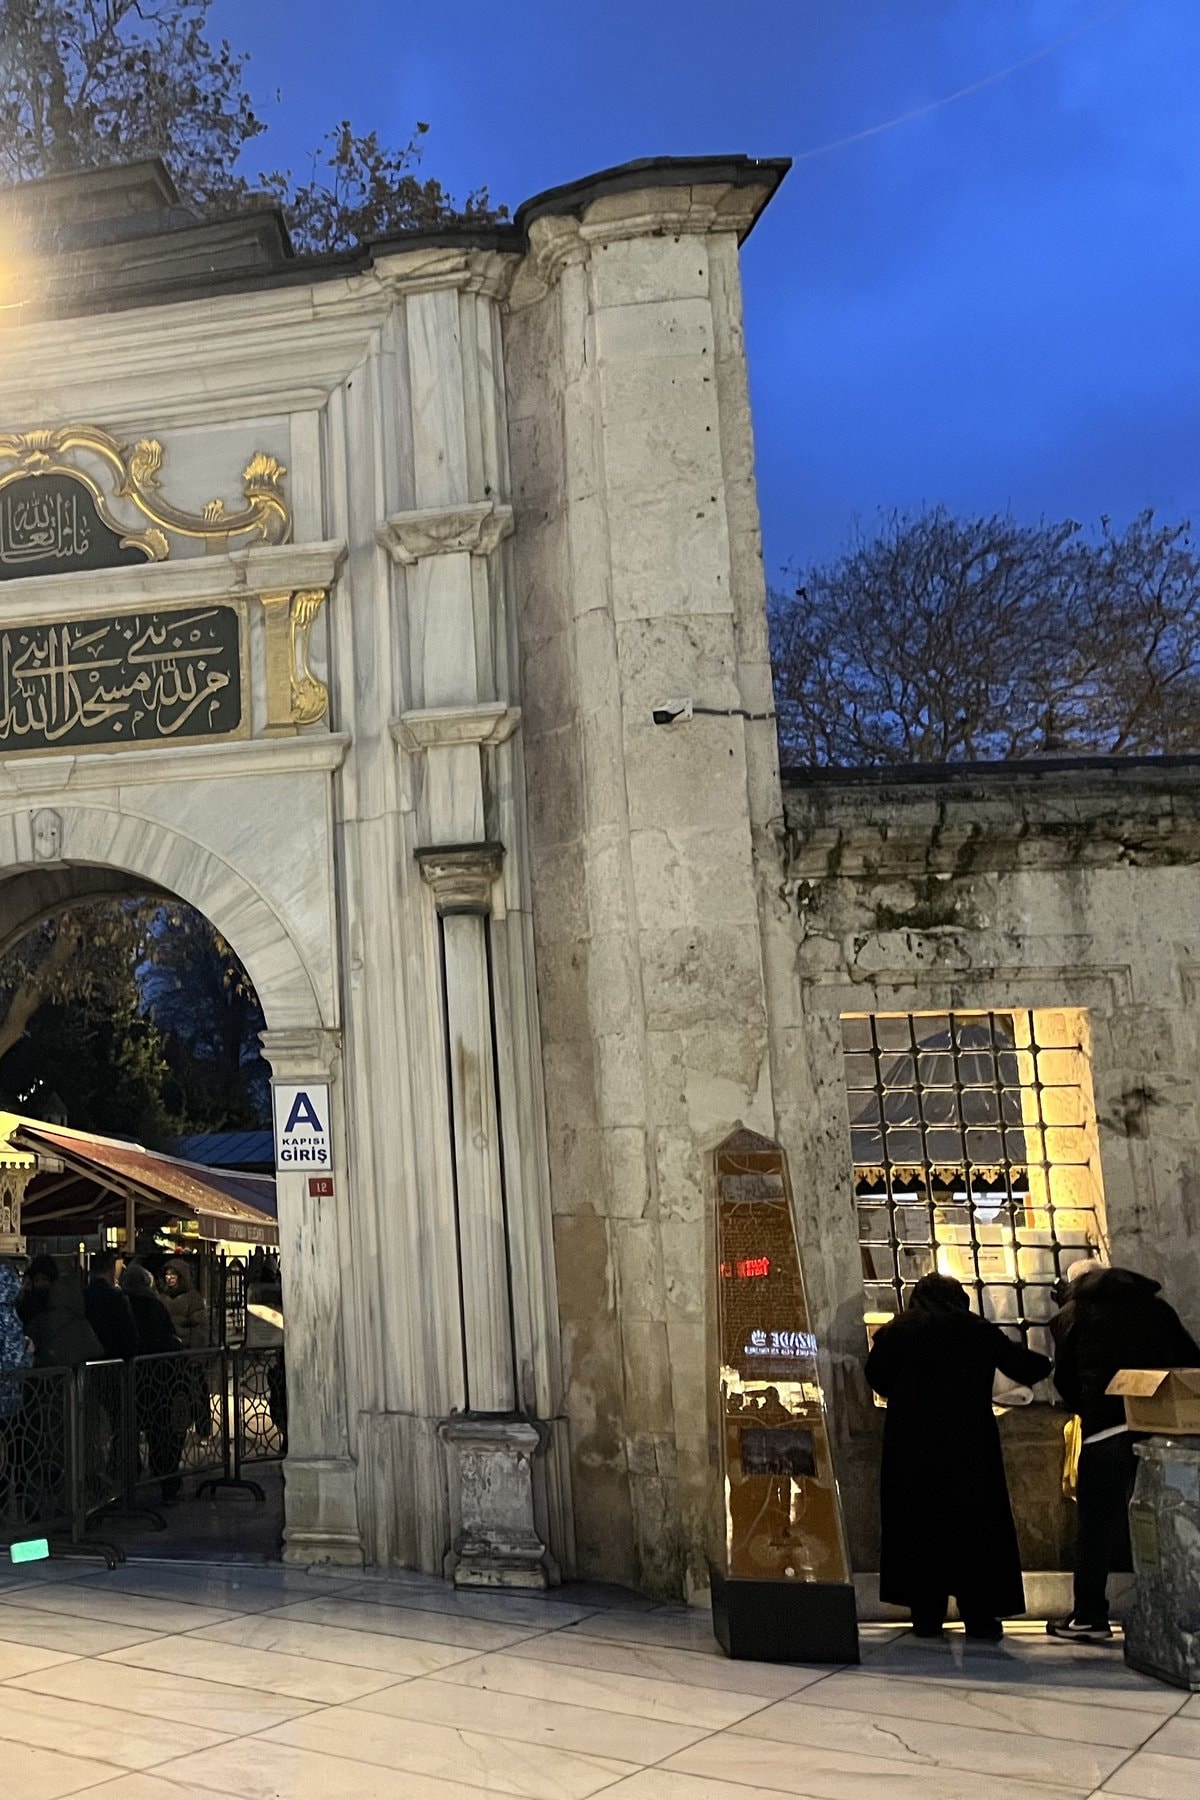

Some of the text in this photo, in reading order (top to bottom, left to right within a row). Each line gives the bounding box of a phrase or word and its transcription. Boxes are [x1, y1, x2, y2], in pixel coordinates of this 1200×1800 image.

[283, 1092, 323, 1133] A
[282, 1137, 325, 1146] KAPISI
[280, 1146, 328, 1164] GİRİŞ
[315, 1182, 328, 1193] 12
